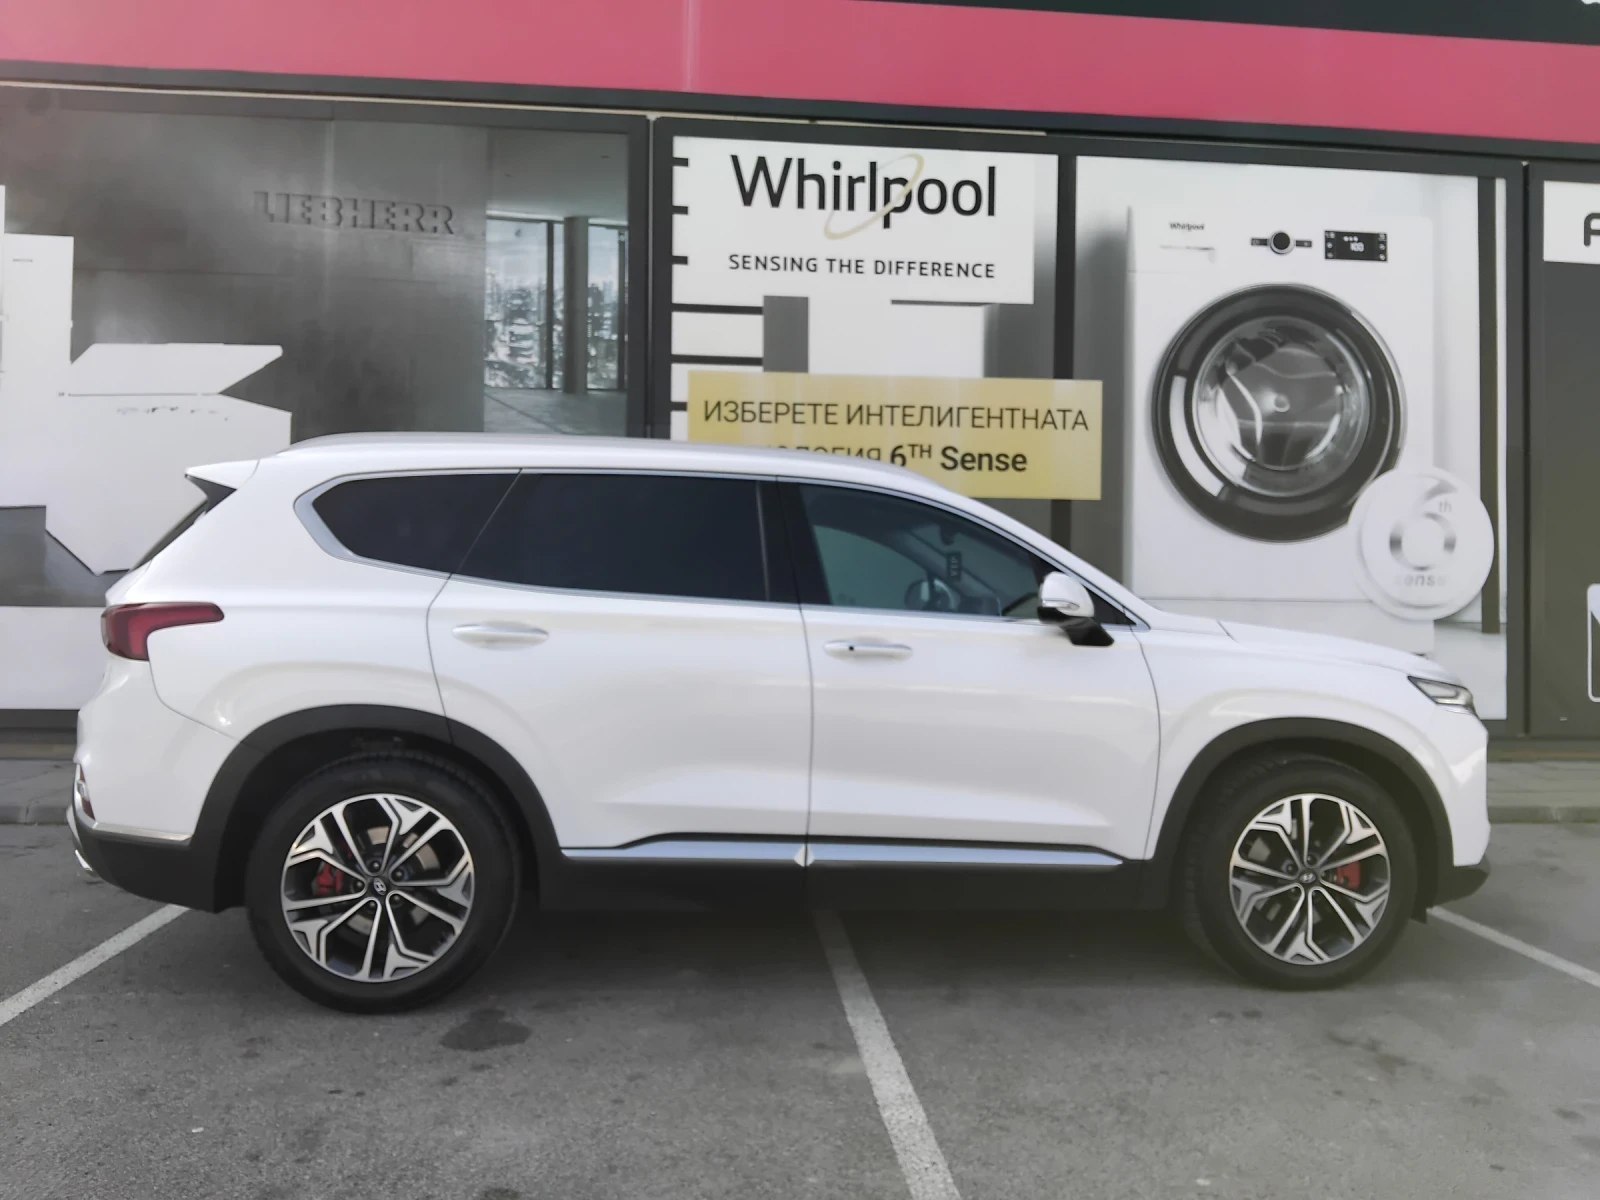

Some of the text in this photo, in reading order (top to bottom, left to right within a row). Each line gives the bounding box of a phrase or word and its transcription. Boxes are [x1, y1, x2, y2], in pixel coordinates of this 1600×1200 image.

[730, 154, 996, 229] Whirlpool
[253, 190, 454, 235] LIEBHERR
[729, 254, 996, 279] SENSING THE DIFFERENCE
[703, 400, 1089, 432] ИЗБЕРЕТЕ ИНТЕЛИГЕНТНАТА
[940, 445, 1028, 474] Sense
